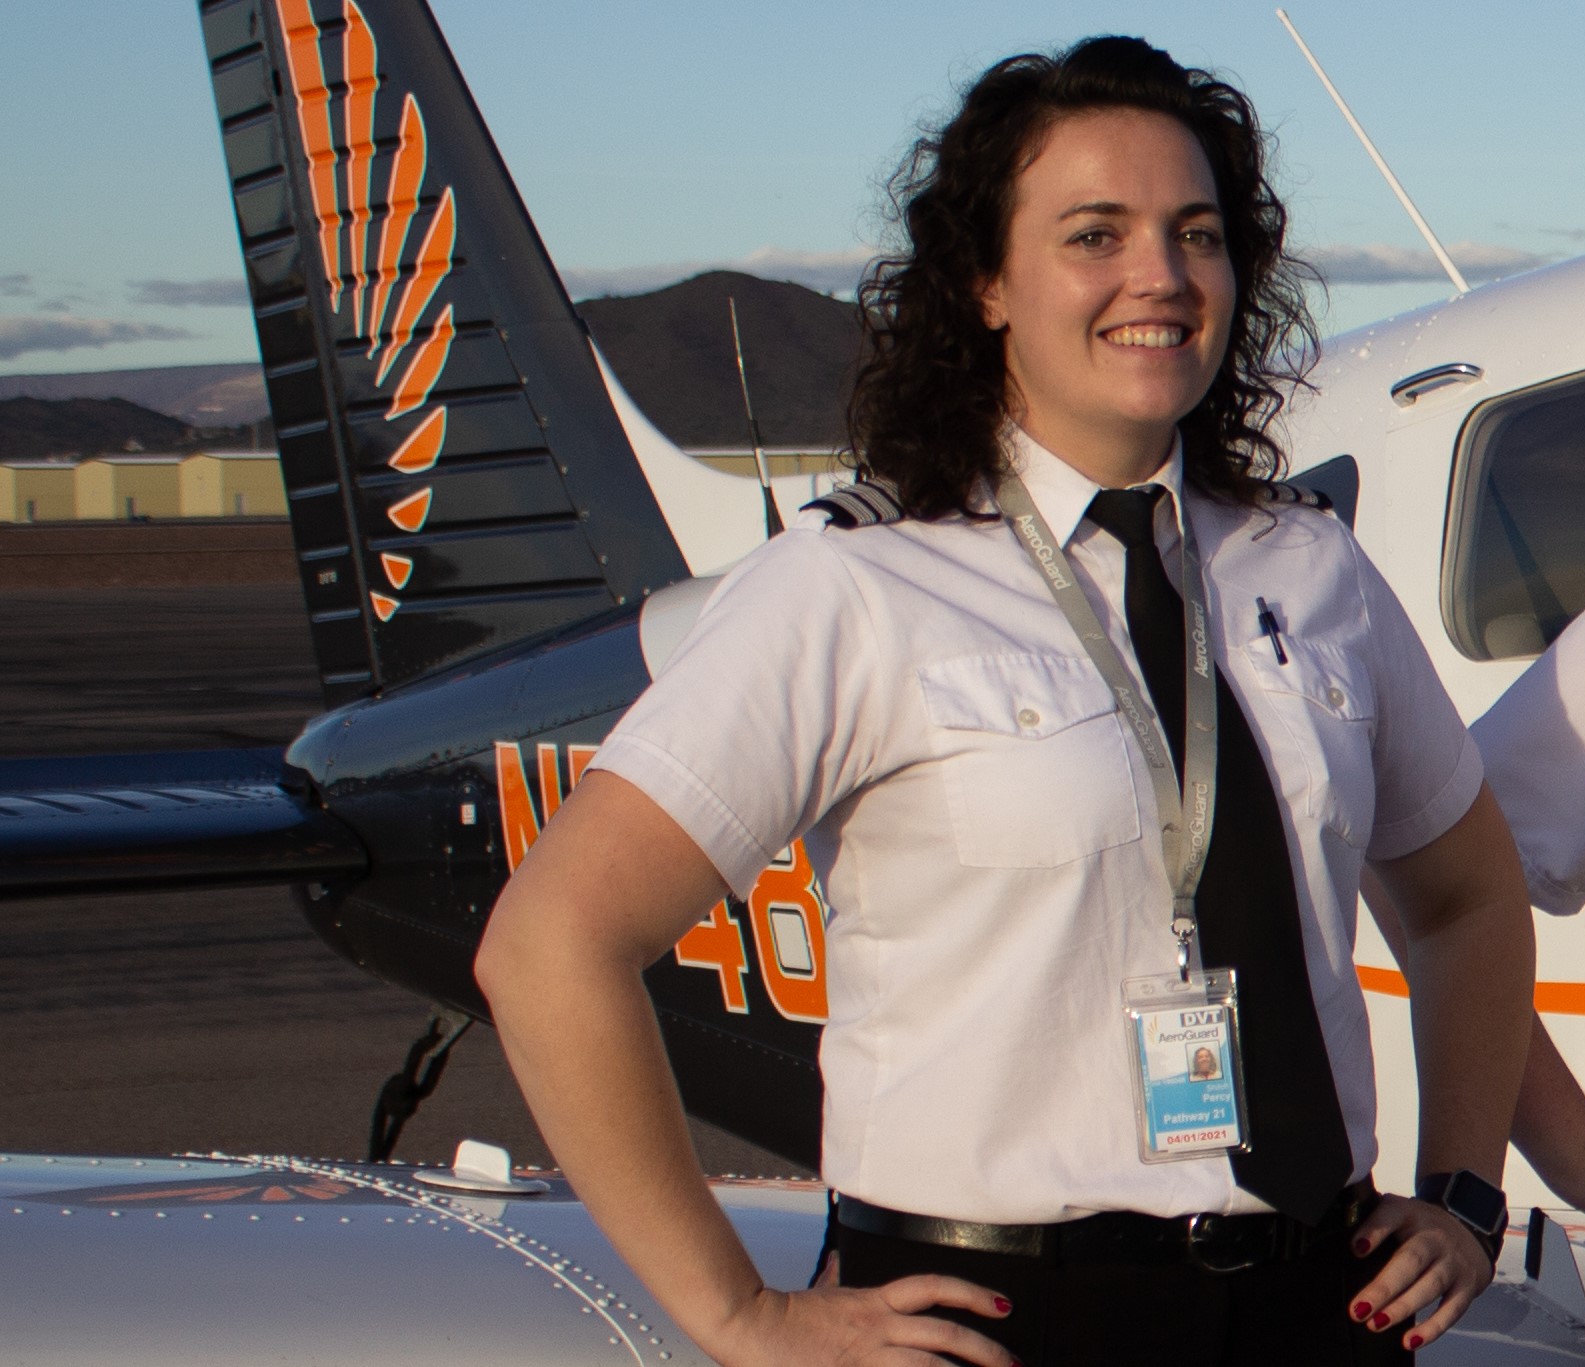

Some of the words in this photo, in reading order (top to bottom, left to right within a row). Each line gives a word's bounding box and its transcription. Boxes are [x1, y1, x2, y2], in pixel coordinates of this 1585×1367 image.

[1016, 514, 1072, 591] AeroGuard
[1192, 601, 1209, 679] AeroGuard
[1184, 782, 1209, 878] AeroGuard
[1183, 1010, 1220, 1027] DVT
[1159, 1027, 1218, 1043] AeroGuard
[1163, 1111, 1210, 1124] Pathway
[1213, 1108, 1226, 1119] 21
[1167, 1130, 1227, 1145] 04/01/2021
